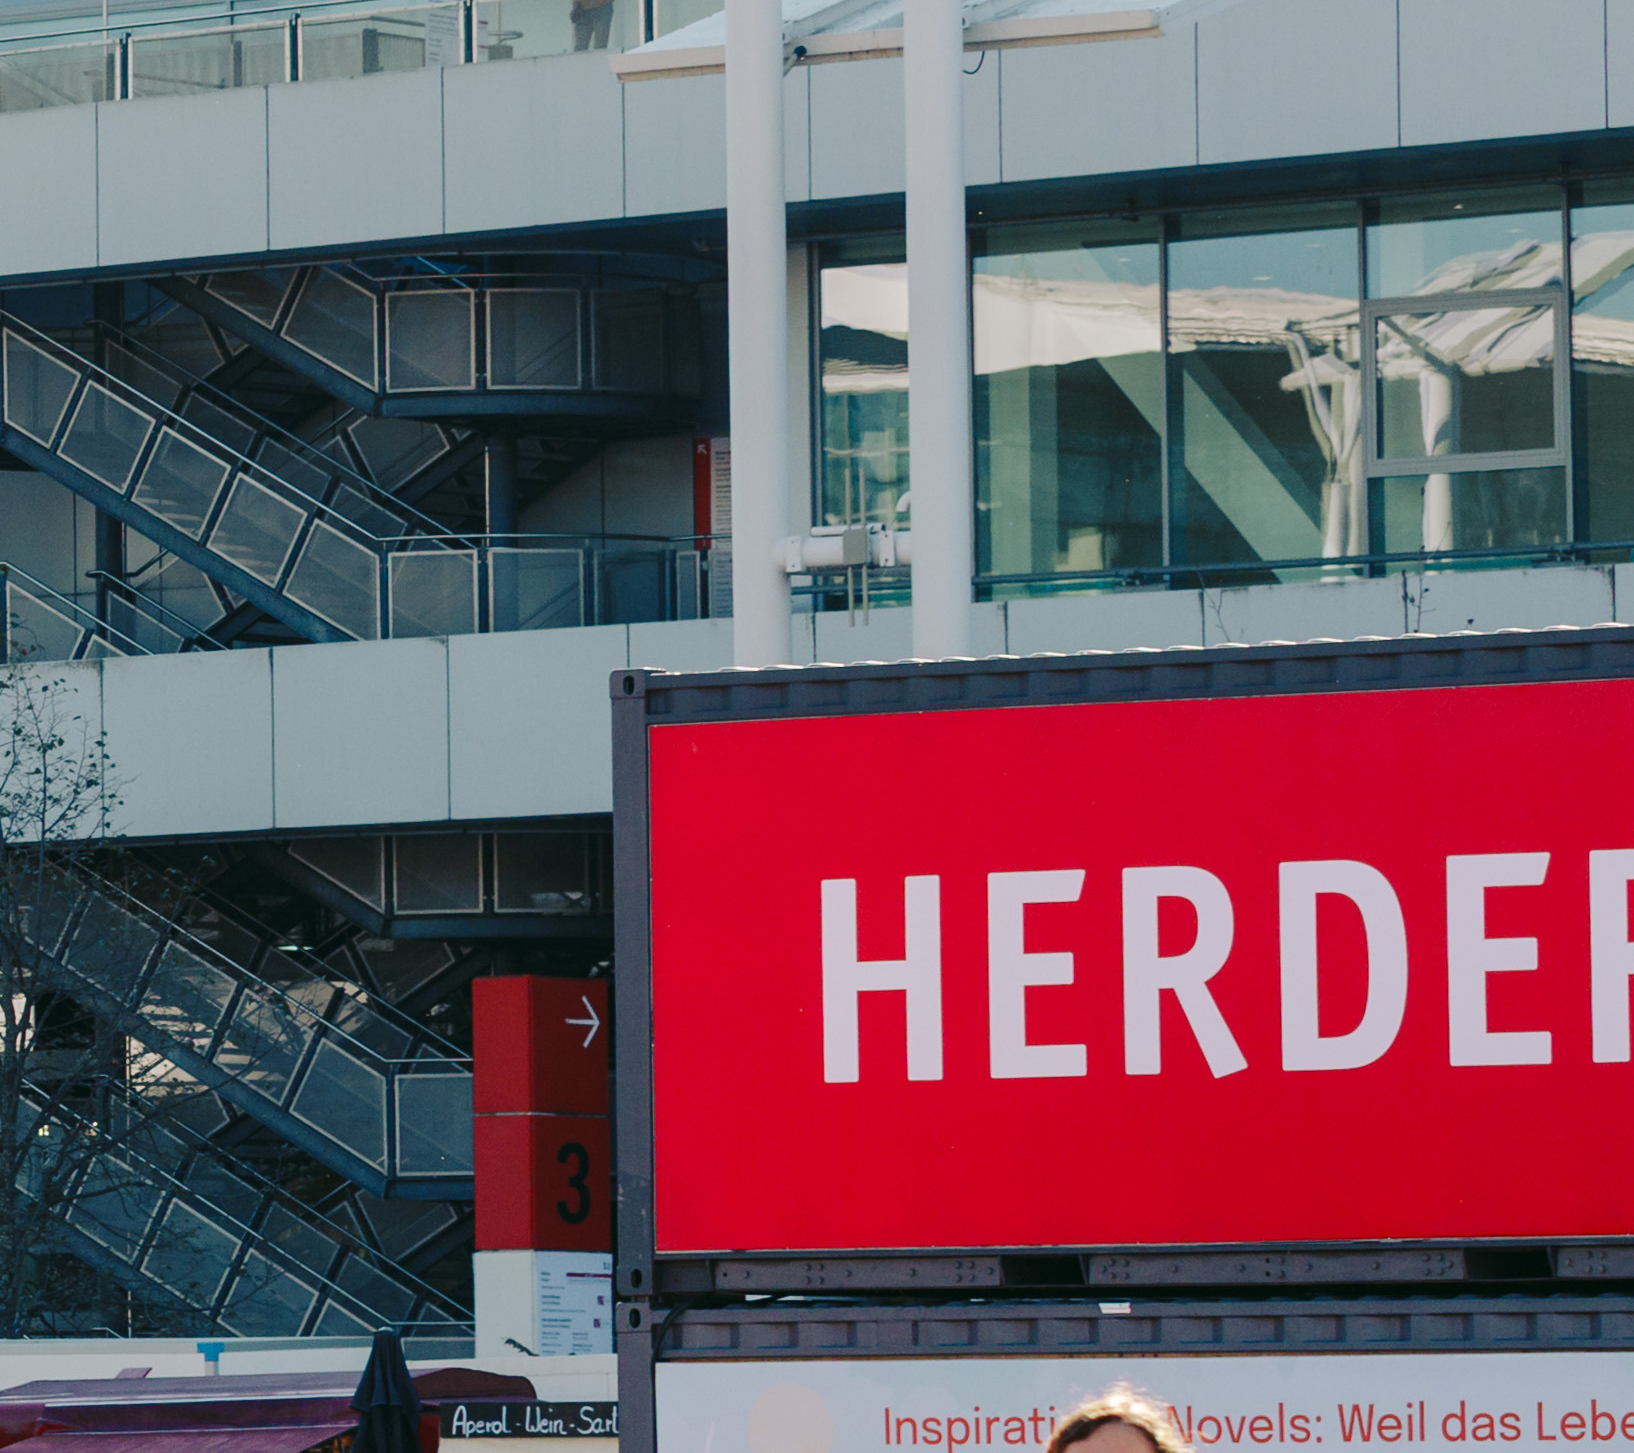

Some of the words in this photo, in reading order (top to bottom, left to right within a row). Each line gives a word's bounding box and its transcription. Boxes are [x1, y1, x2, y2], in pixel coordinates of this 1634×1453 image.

[556, 1143, 591, 1224] 3
[452, 1405, 512, 1437] Aperol
[525, 1406, 567, 1435] Wein
[1166, 1402, 1323, 1444] Novels:
[1338, 1400, 1425, 1442] Weil
[1441, 1399, 1521, 1441] das
